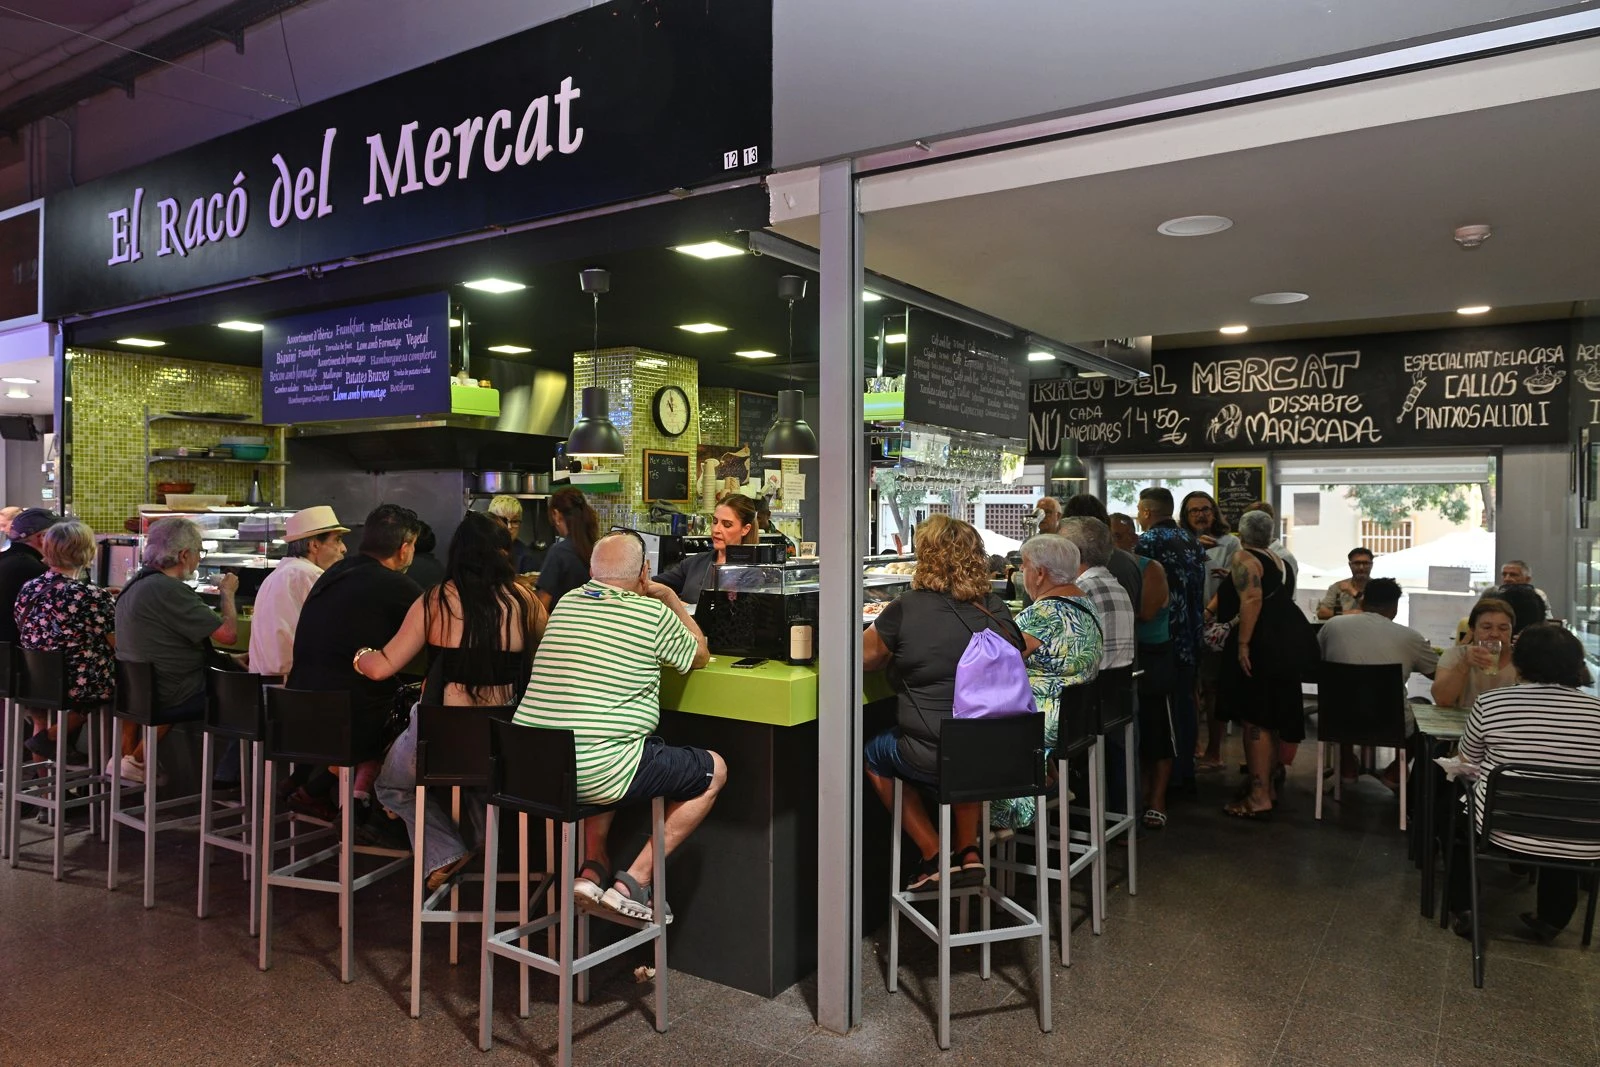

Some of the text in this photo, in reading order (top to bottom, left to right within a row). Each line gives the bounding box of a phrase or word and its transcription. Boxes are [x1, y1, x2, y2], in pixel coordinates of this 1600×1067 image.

[726, 148, 756, 168] 12 13
[108, 76, 584, 266] El Racó del Mercat
[336, 316, 364, 336] Frankfurt
[406, 326, 429, 349] Vegetal
[298, 344, 320, 358] Frankfurt
[1404, 350, 1492, 372] ESPECIALITAT
[346, 369, 390, 384] Patates Braves
[1192, 351, 1360, 394] MERCAT
[348, 385, 360, 400] amb
[361, 384, 387, 402] formatge
[1445, 370, 1518, 399] CALLOS
[1070, 406, 1103, 420] CADA
[1415, 404, 1481, 430] PINTXOS
